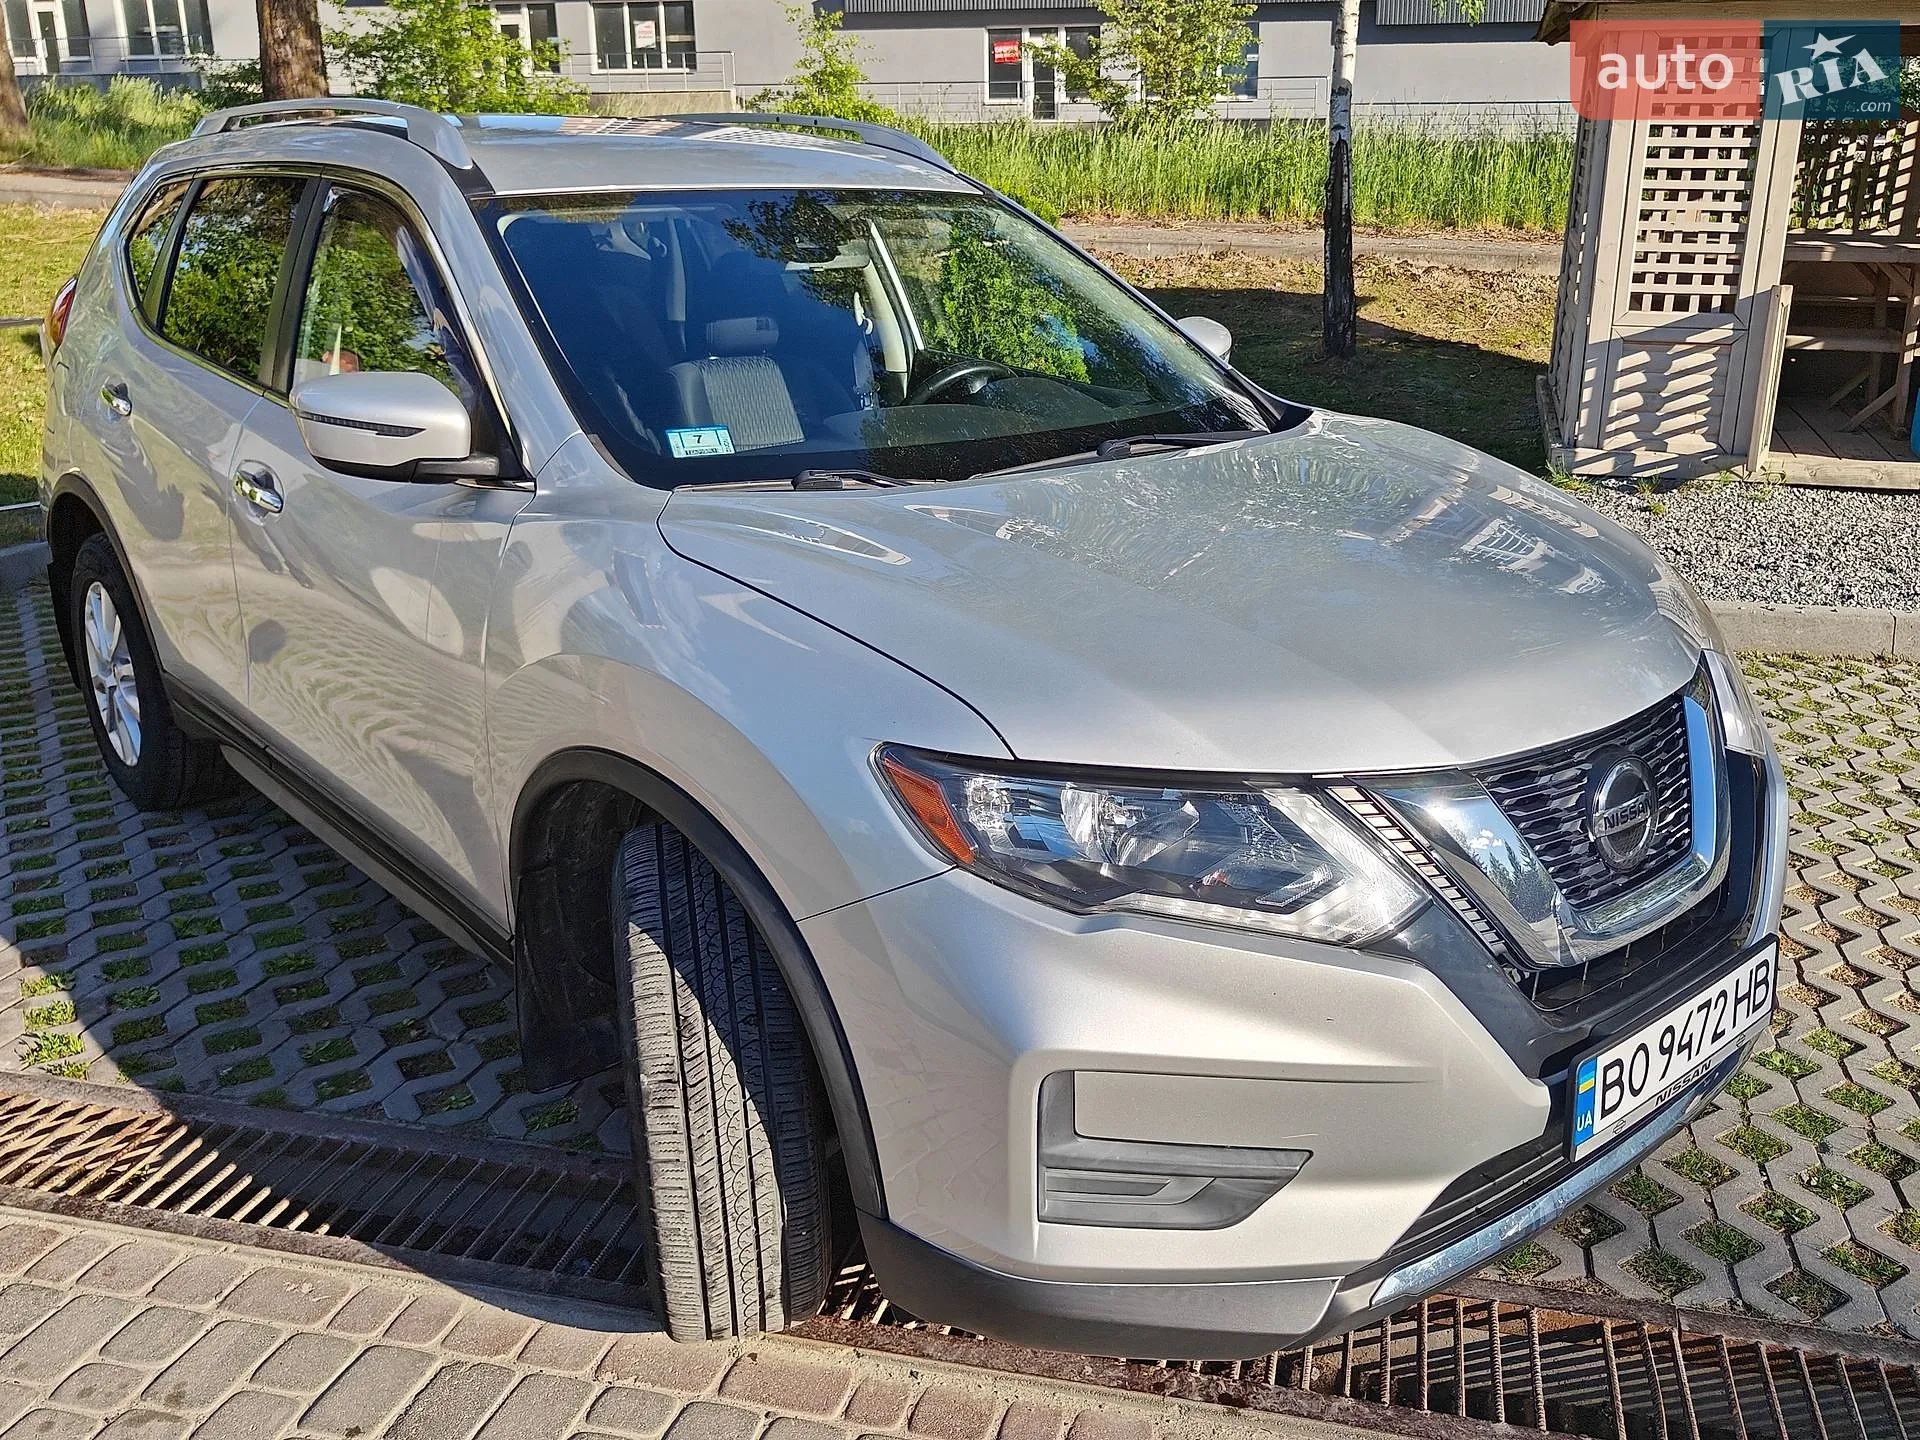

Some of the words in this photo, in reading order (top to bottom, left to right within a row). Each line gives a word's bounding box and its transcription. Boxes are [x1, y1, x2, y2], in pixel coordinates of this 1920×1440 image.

[693, 434, 702, 444] 7
[1603, 797, 1653, 831] NISSAN
[1600, 1042, 1650, 1121] BO
[1658, 989, 1728, 1082] 9472
[1732, 958, 1770, 1029] HB
[1654, 1060, 1712, 1108] NISSAN
[1576, 1110, 1593, 1132] UA
